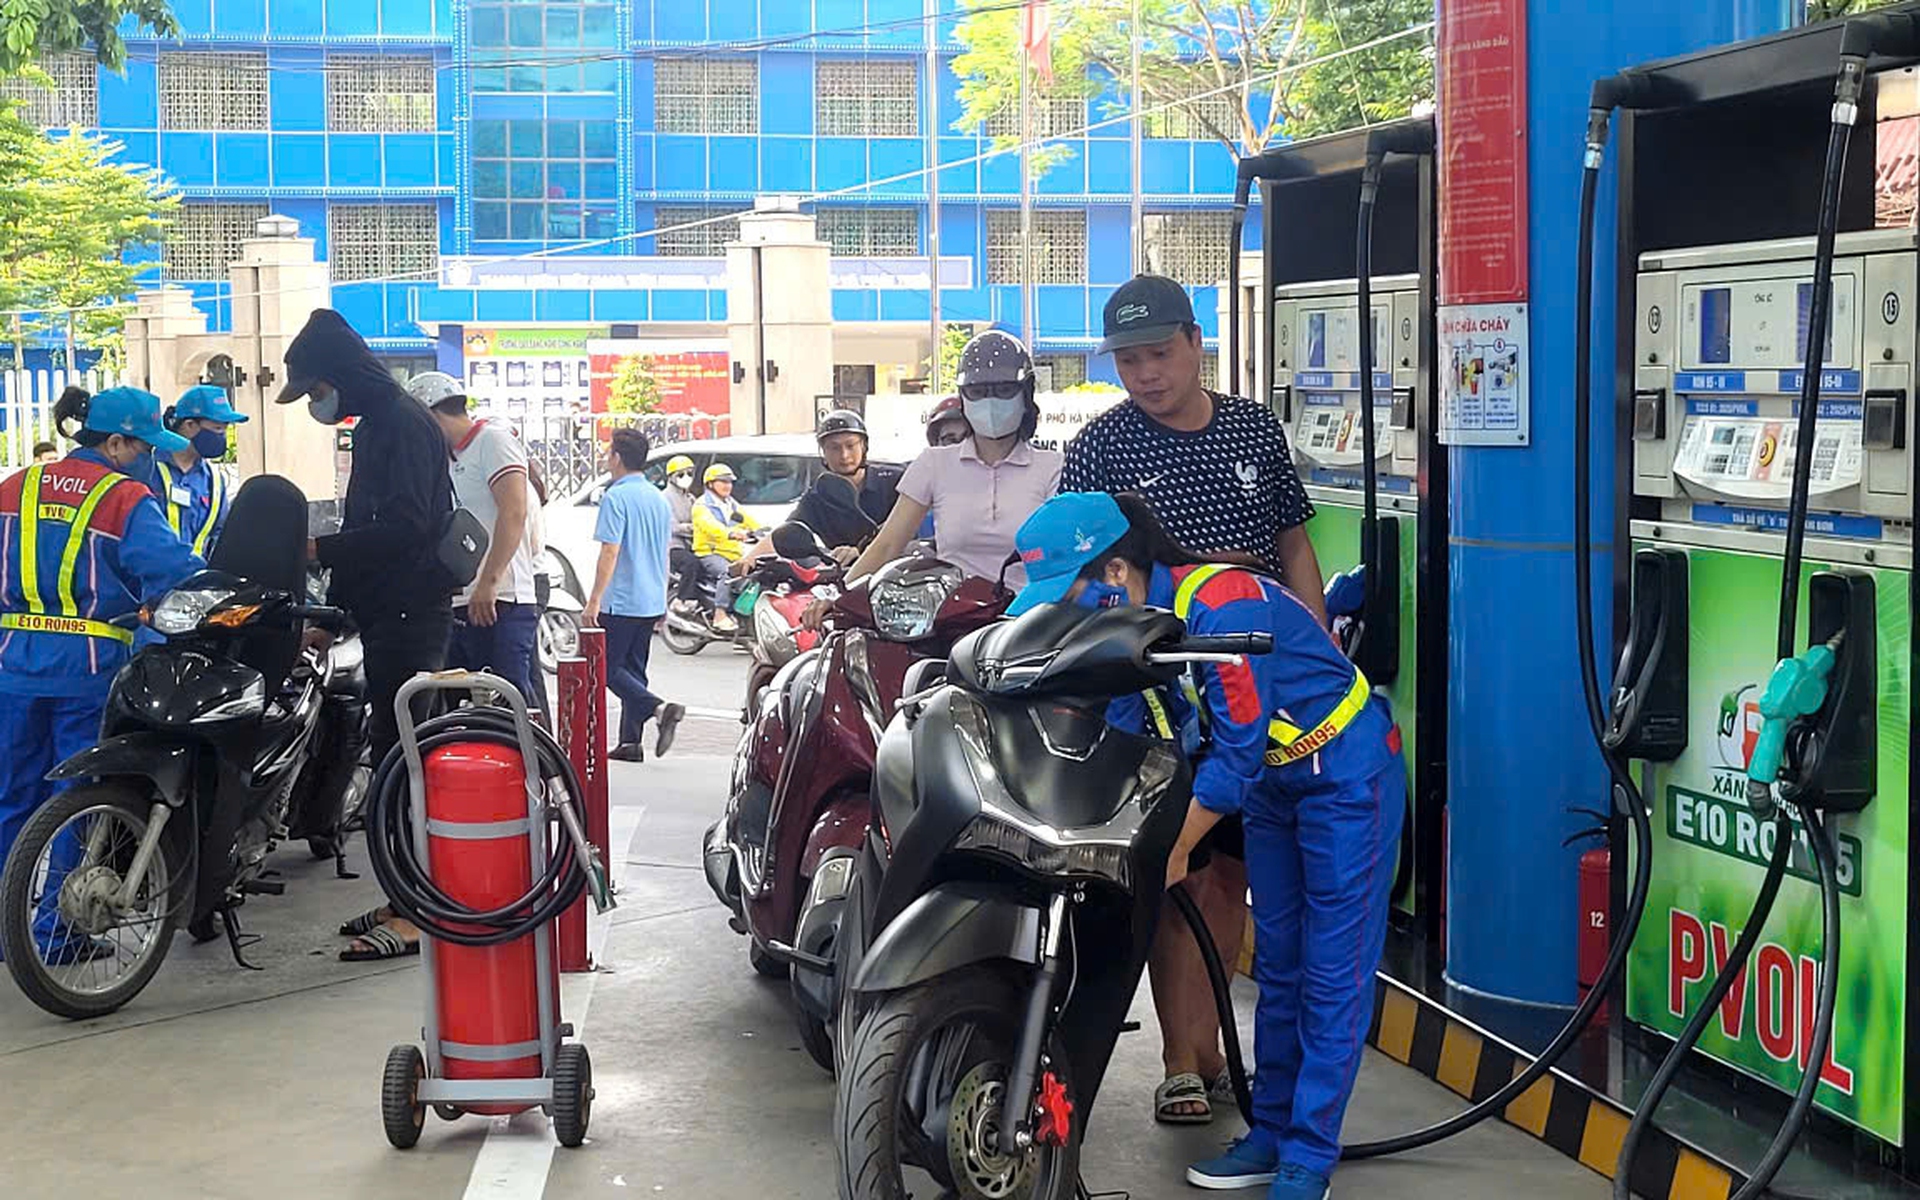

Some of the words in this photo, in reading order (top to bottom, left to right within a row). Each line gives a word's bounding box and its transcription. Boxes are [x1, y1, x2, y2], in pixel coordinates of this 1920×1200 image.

[41, 474, 89, 495] PVOIL
[18, 615, 41, 629] E10
[44, 618, 86, 632] RON95
[1285, 720, 1338, 759] RON95
[1712, 773, 1746, 800] XĂN
[1675, 793, 1728, 847] E10
[1590, 911, 1605, 928] 12
[1668, 906, 1854, 1097] PVOIL
